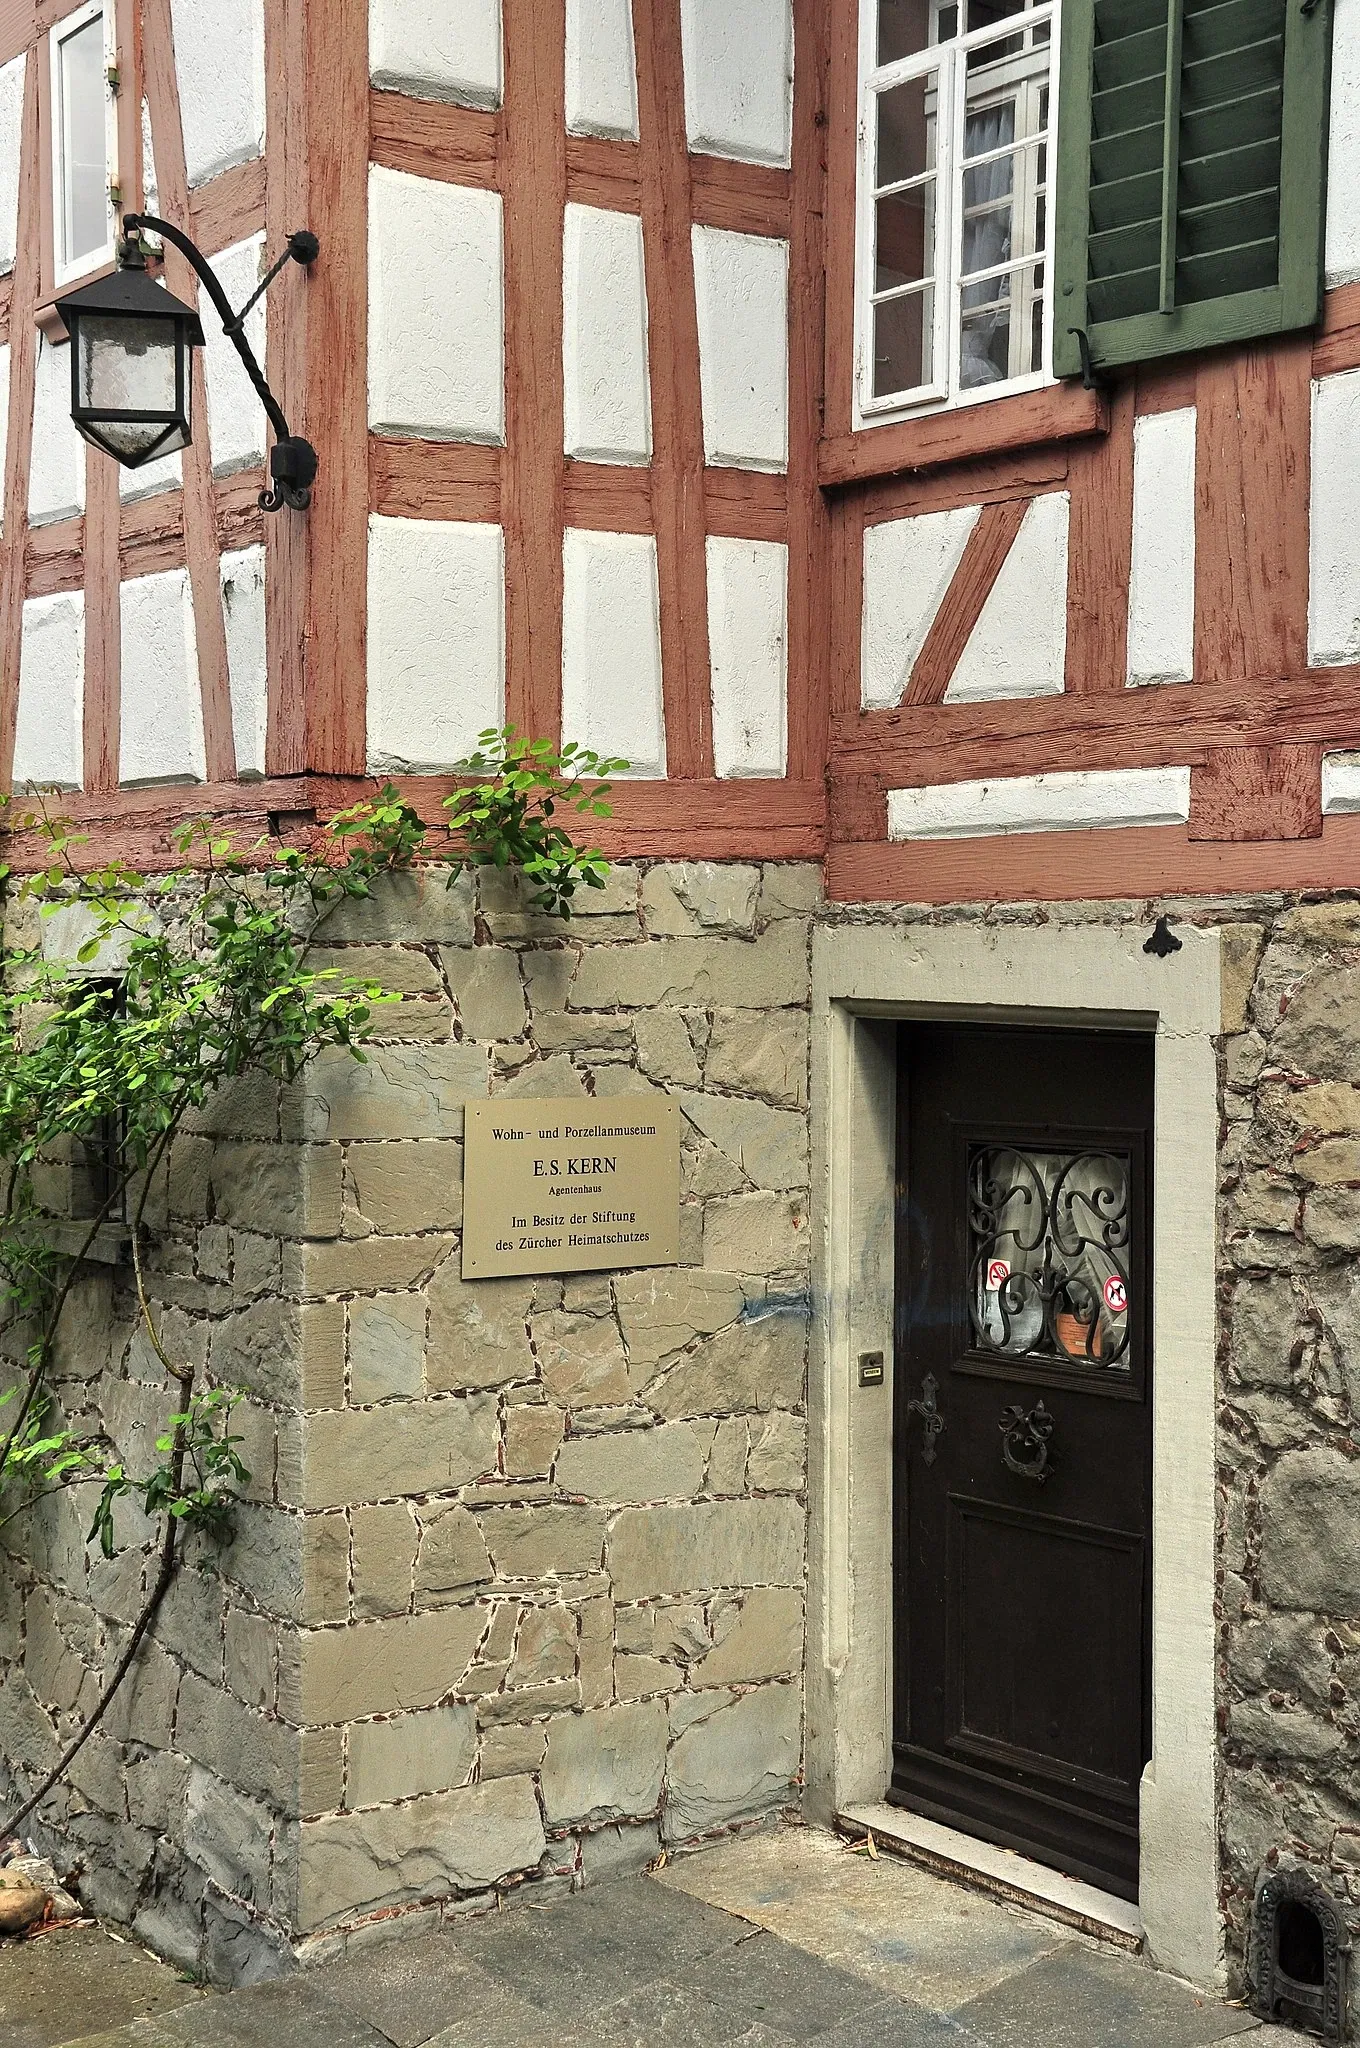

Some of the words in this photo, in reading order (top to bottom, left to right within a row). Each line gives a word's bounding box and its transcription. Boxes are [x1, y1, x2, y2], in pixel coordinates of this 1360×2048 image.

[492, 1128, 531, 1140] Wohn-
[538, 1126, 559, 1139] und
[565, 1125, 656, 1138] Porzellanmuseum
[567, 1157, 617, 1175] KERN
[548, 1184, 602, 1197] Agentenhaus
[511, 1216, 527, 1228] Im
[533, 1214, 565, 1227] Besitz
[570, 1212, 587, 1224] der
[592, 1211, 636, 1224] Stiftung
[495, 1239, 513, 1251] des
[518, 1236, 562, 1249] Zürcher
[568, 1232, 650, 1247] Heimatschutzes
